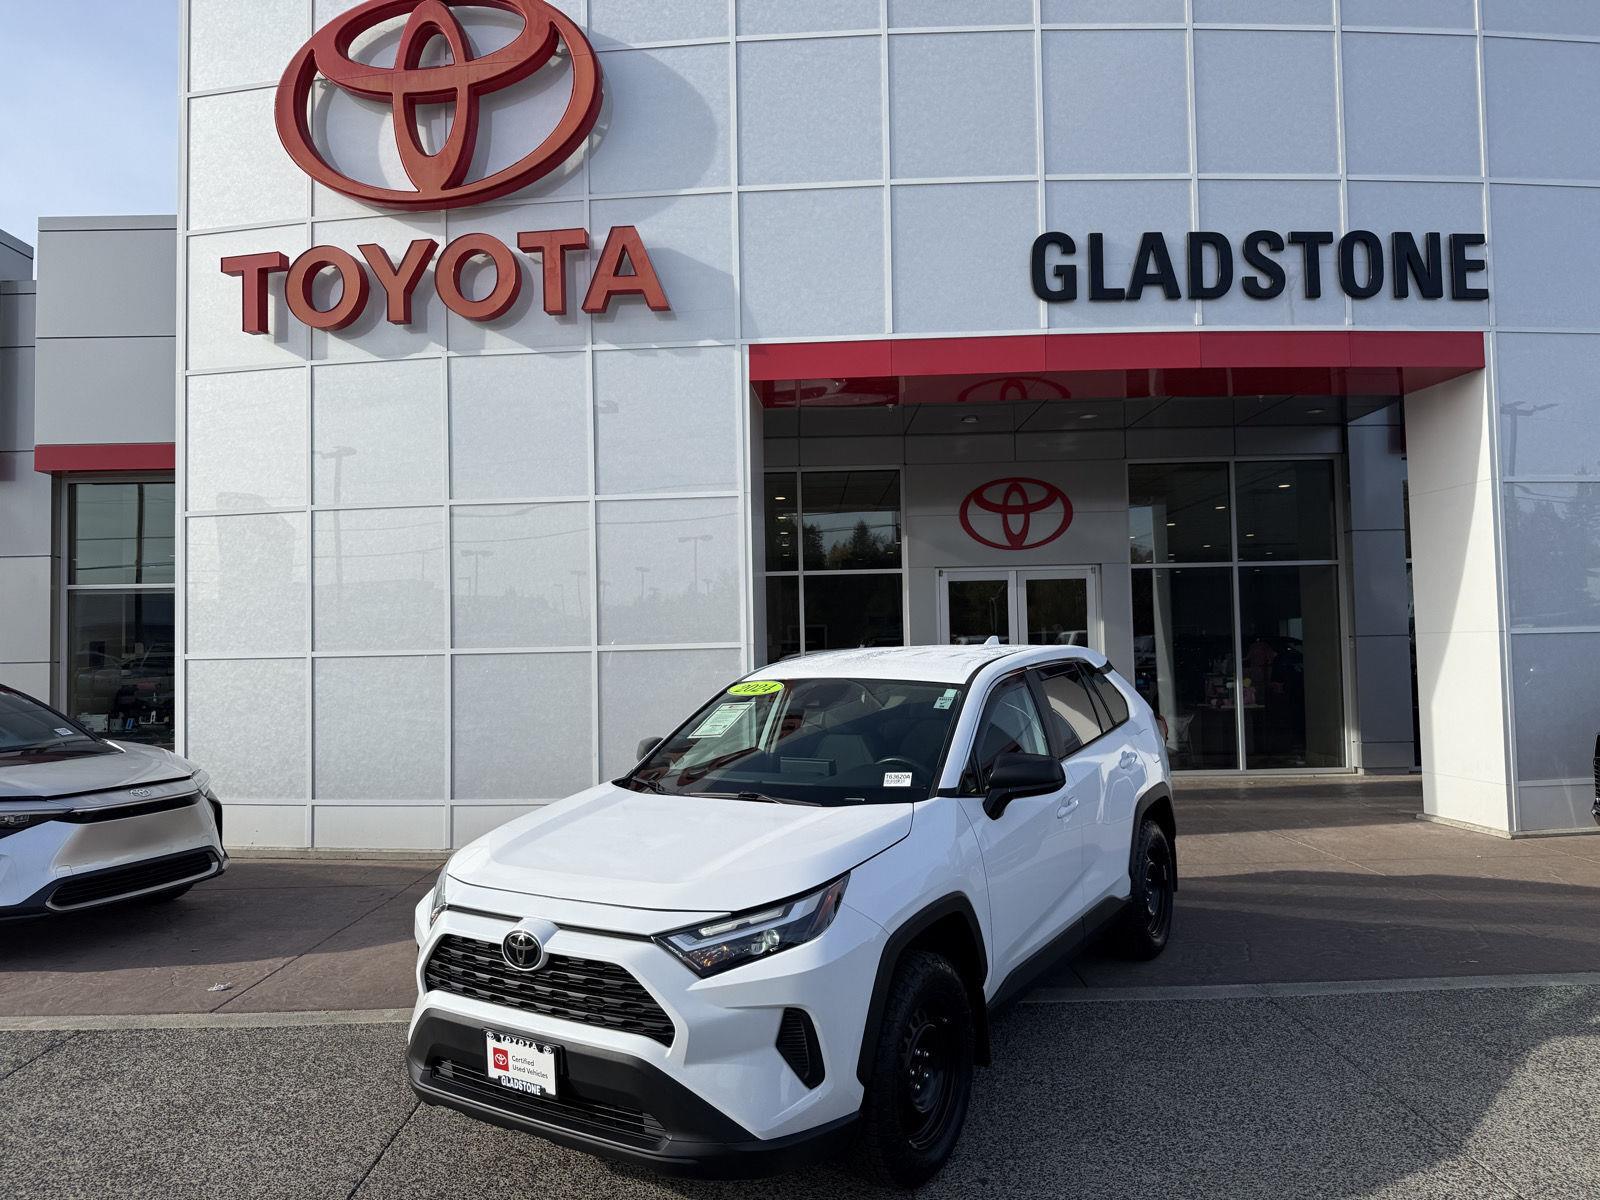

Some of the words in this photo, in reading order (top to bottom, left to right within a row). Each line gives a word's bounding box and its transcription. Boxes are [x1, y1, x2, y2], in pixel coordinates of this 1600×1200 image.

[1030, 230, 1489, 303] GLADSTONE
[221, 225, 671, 335] TOYOTA
[734, 684, 778, 693] 2024
[499, 1034, 538, 1050] TOYOTA
[512, 1055, 535, 1067] Certified
[513, 1064, 526, 1073] Used
[526, 1067, 549, 1080] Vehicles
[500, 1075, 541, 1096] GLADSTONE
